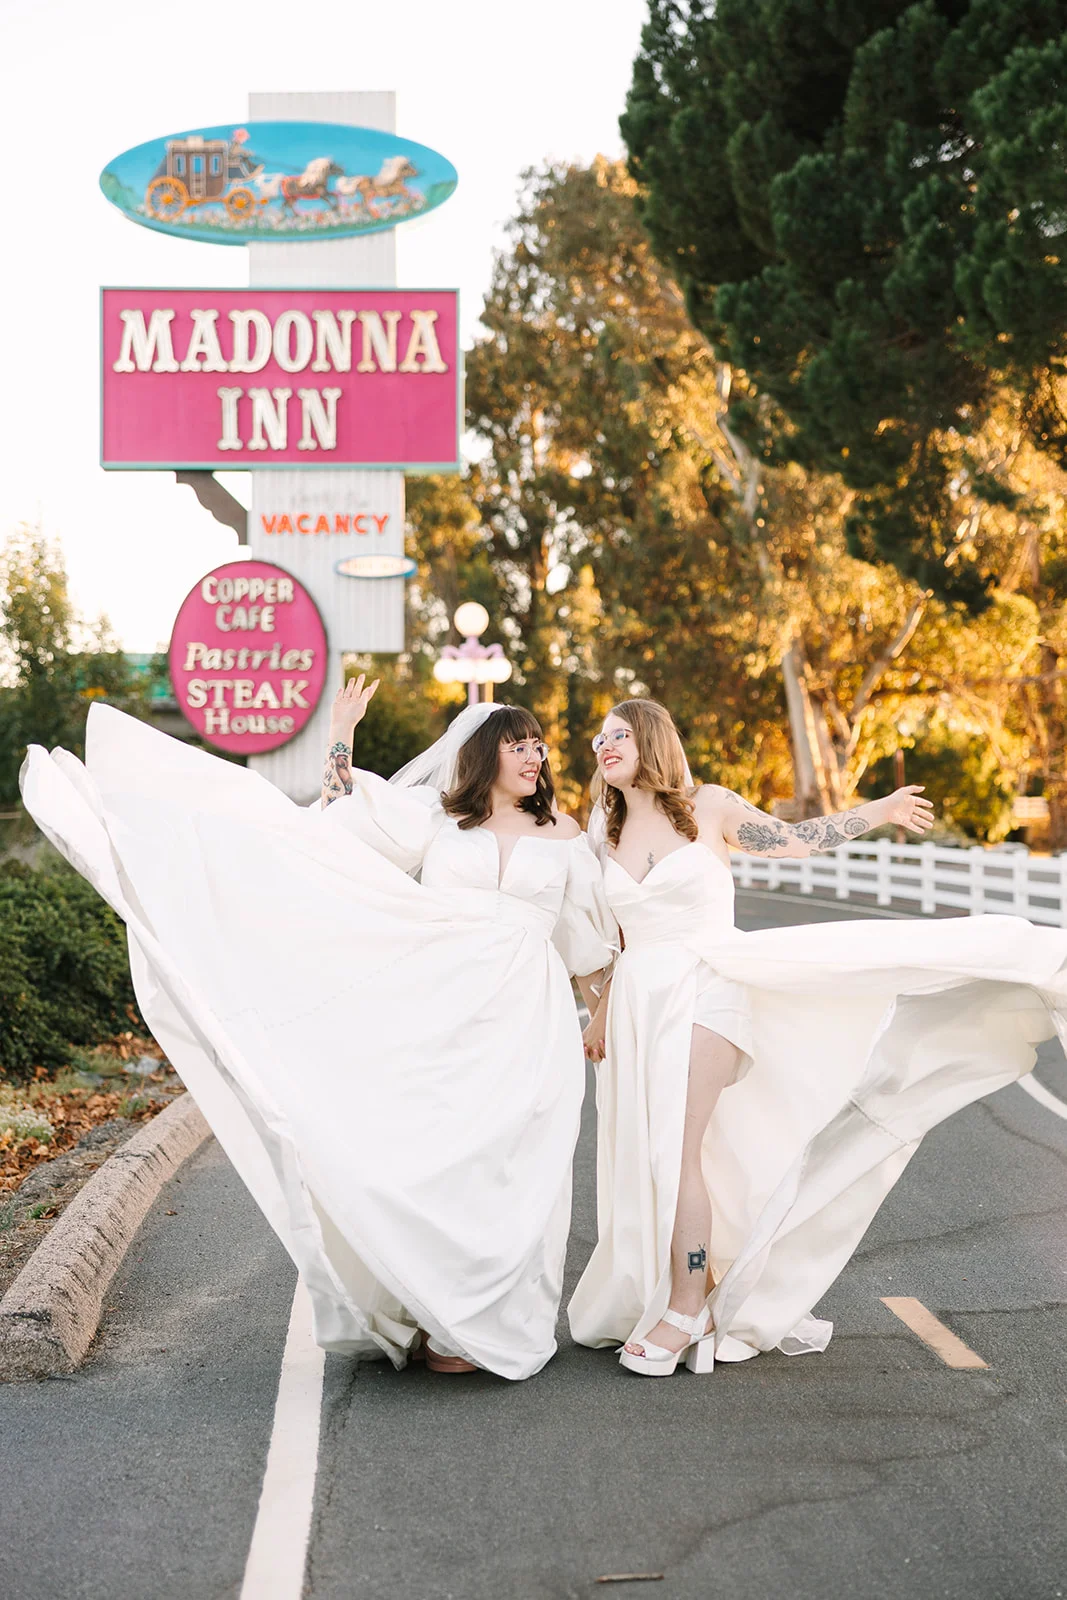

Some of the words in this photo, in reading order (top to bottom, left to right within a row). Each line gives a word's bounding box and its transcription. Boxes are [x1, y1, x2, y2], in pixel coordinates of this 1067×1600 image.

[113, 309, 448, 373] MADONNA
[217, 387, 342, 450] INN
[261, 513, 389, 535] VACANCY
[201, 576, 294, 604] COPPER
[215, 605, 275, 632] CAFE
[183, 642, 314, 672] Pastries
[187, 678, 311, 709] STEAK
[204, 708, 295, 735] House
